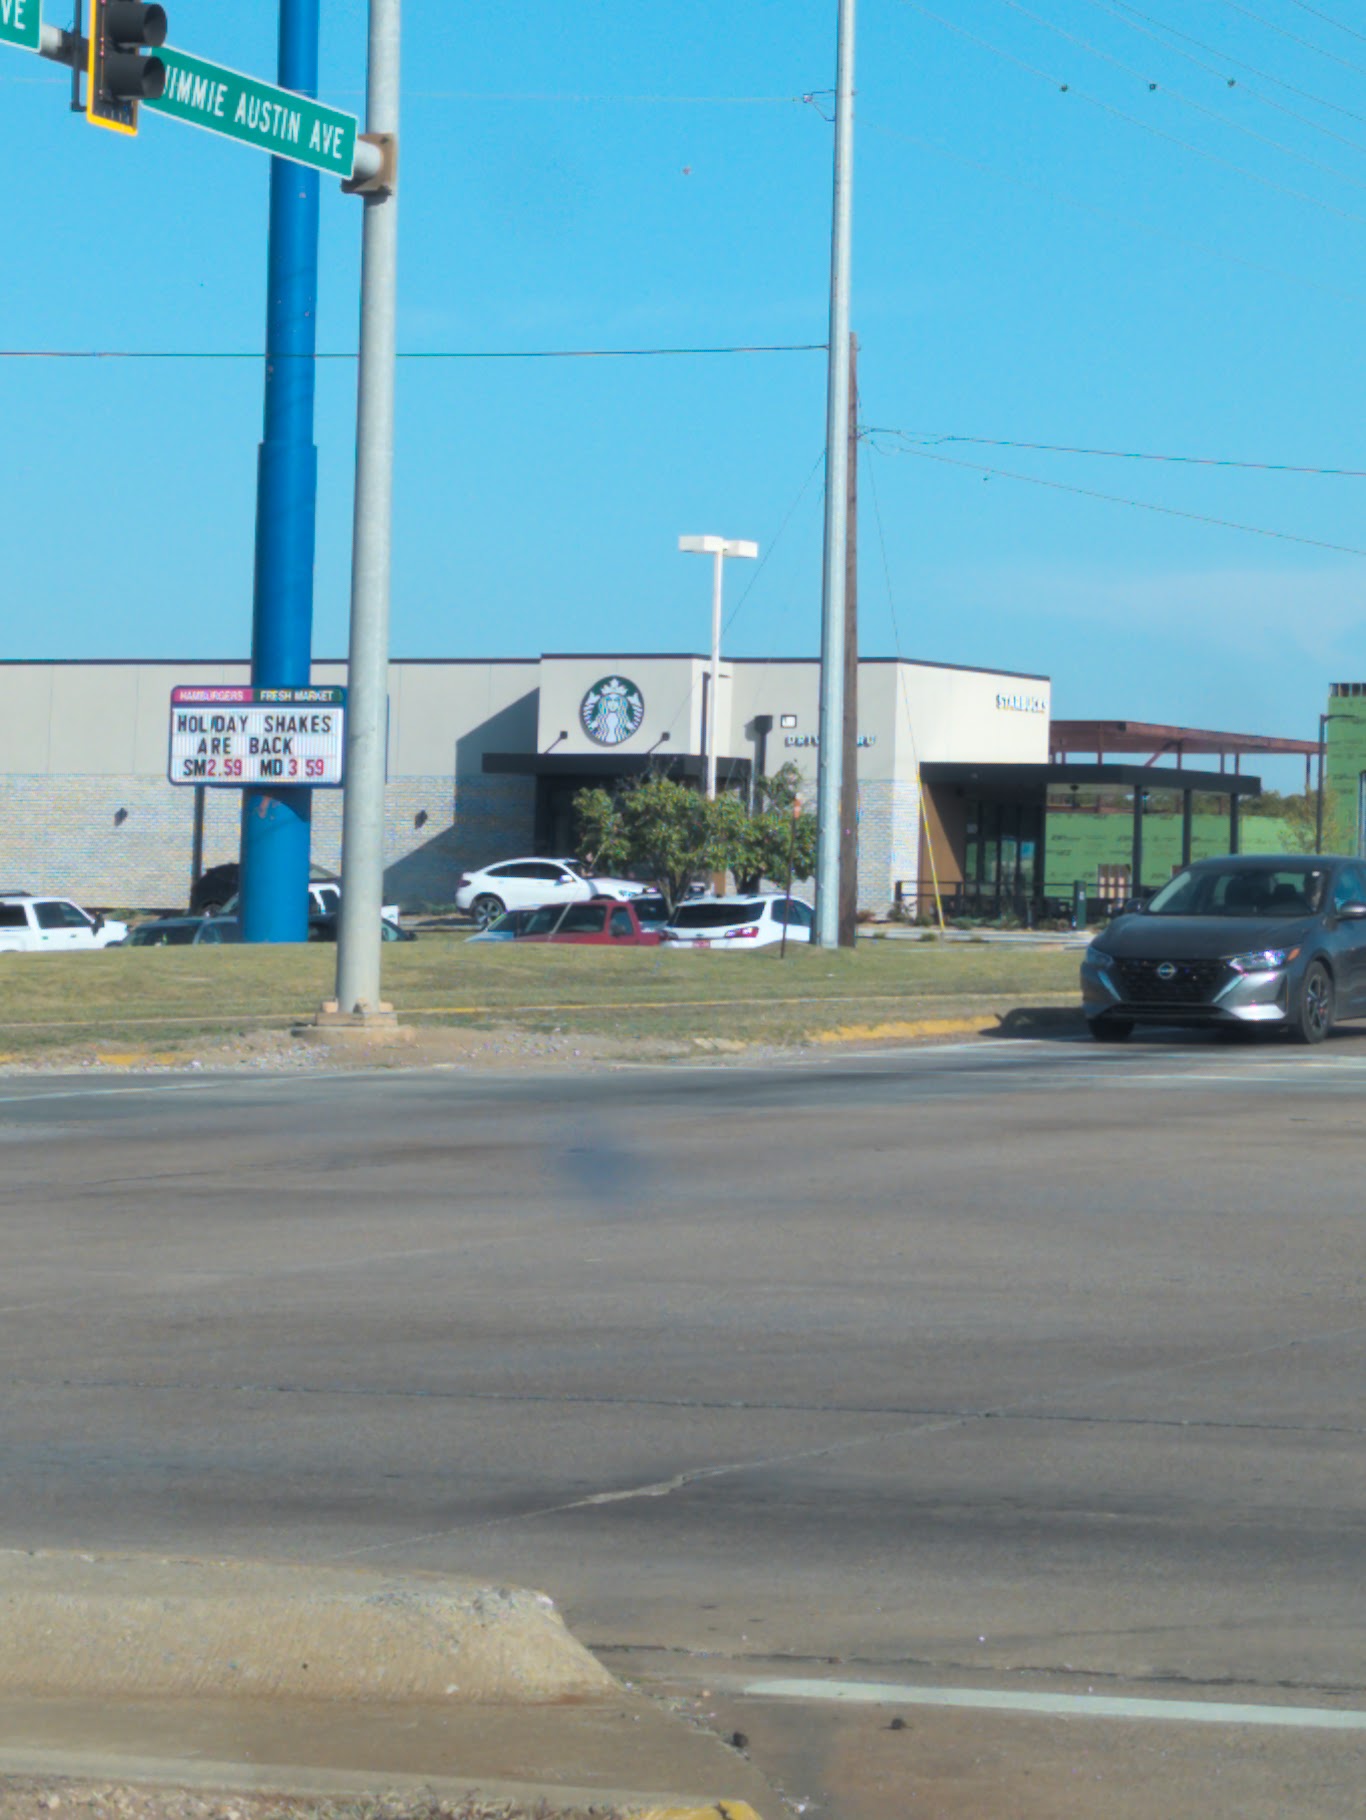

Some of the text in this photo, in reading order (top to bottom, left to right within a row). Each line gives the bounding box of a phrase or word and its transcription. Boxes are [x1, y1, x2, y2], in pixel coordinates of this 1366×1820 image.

[234, 91, 301, 144] AUSTIN
[309, 119, 344, 159] AVE
[180, 690, 244, 701] HAMBURGERS
[260, 690, 333, 701] FRESH MARKET
[178, 715, 332, 733] HOLIDAY SHAKES
[197, 736, 293, 755] ARE BACK
[260, 758, 282, 777] MD
